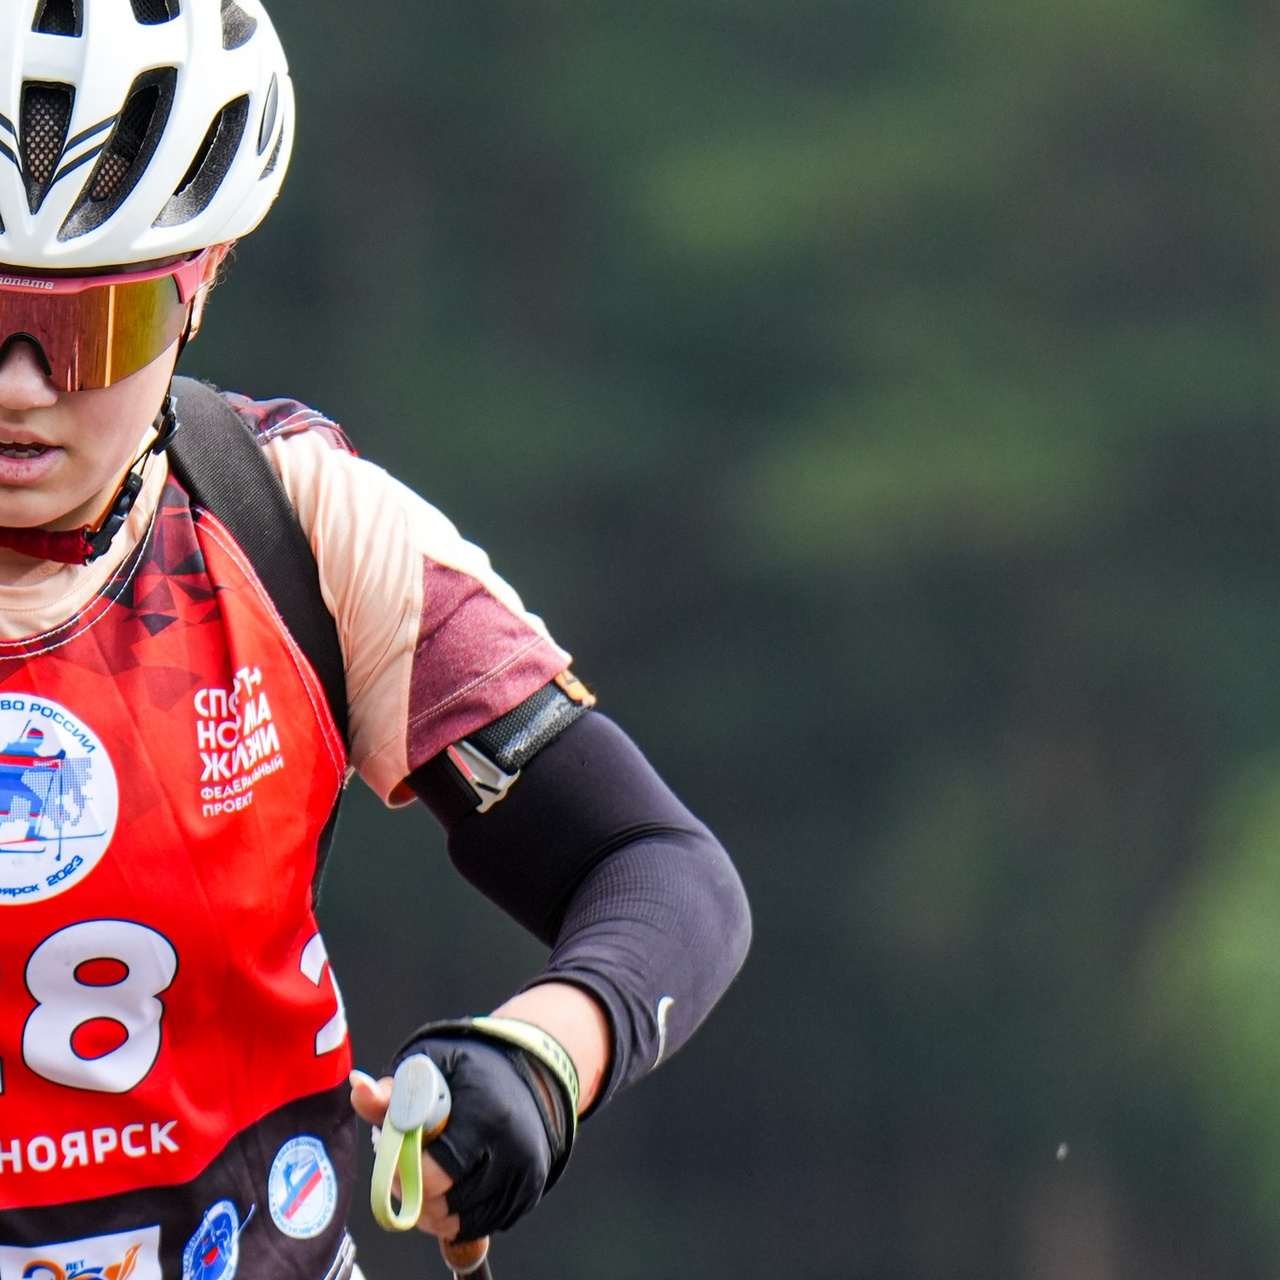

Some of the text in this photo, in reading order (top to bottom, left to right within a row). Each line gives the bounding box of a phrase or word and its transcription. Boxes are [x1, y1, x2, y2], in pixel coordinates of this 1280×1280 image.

[29, 702, 96, 754] РОССИИ
[202, 791, 253, 818] ПРОЕКТ
[45, 854, 85, 887] 2023
[65, 1259, 85, 1271] ЛЕТ
